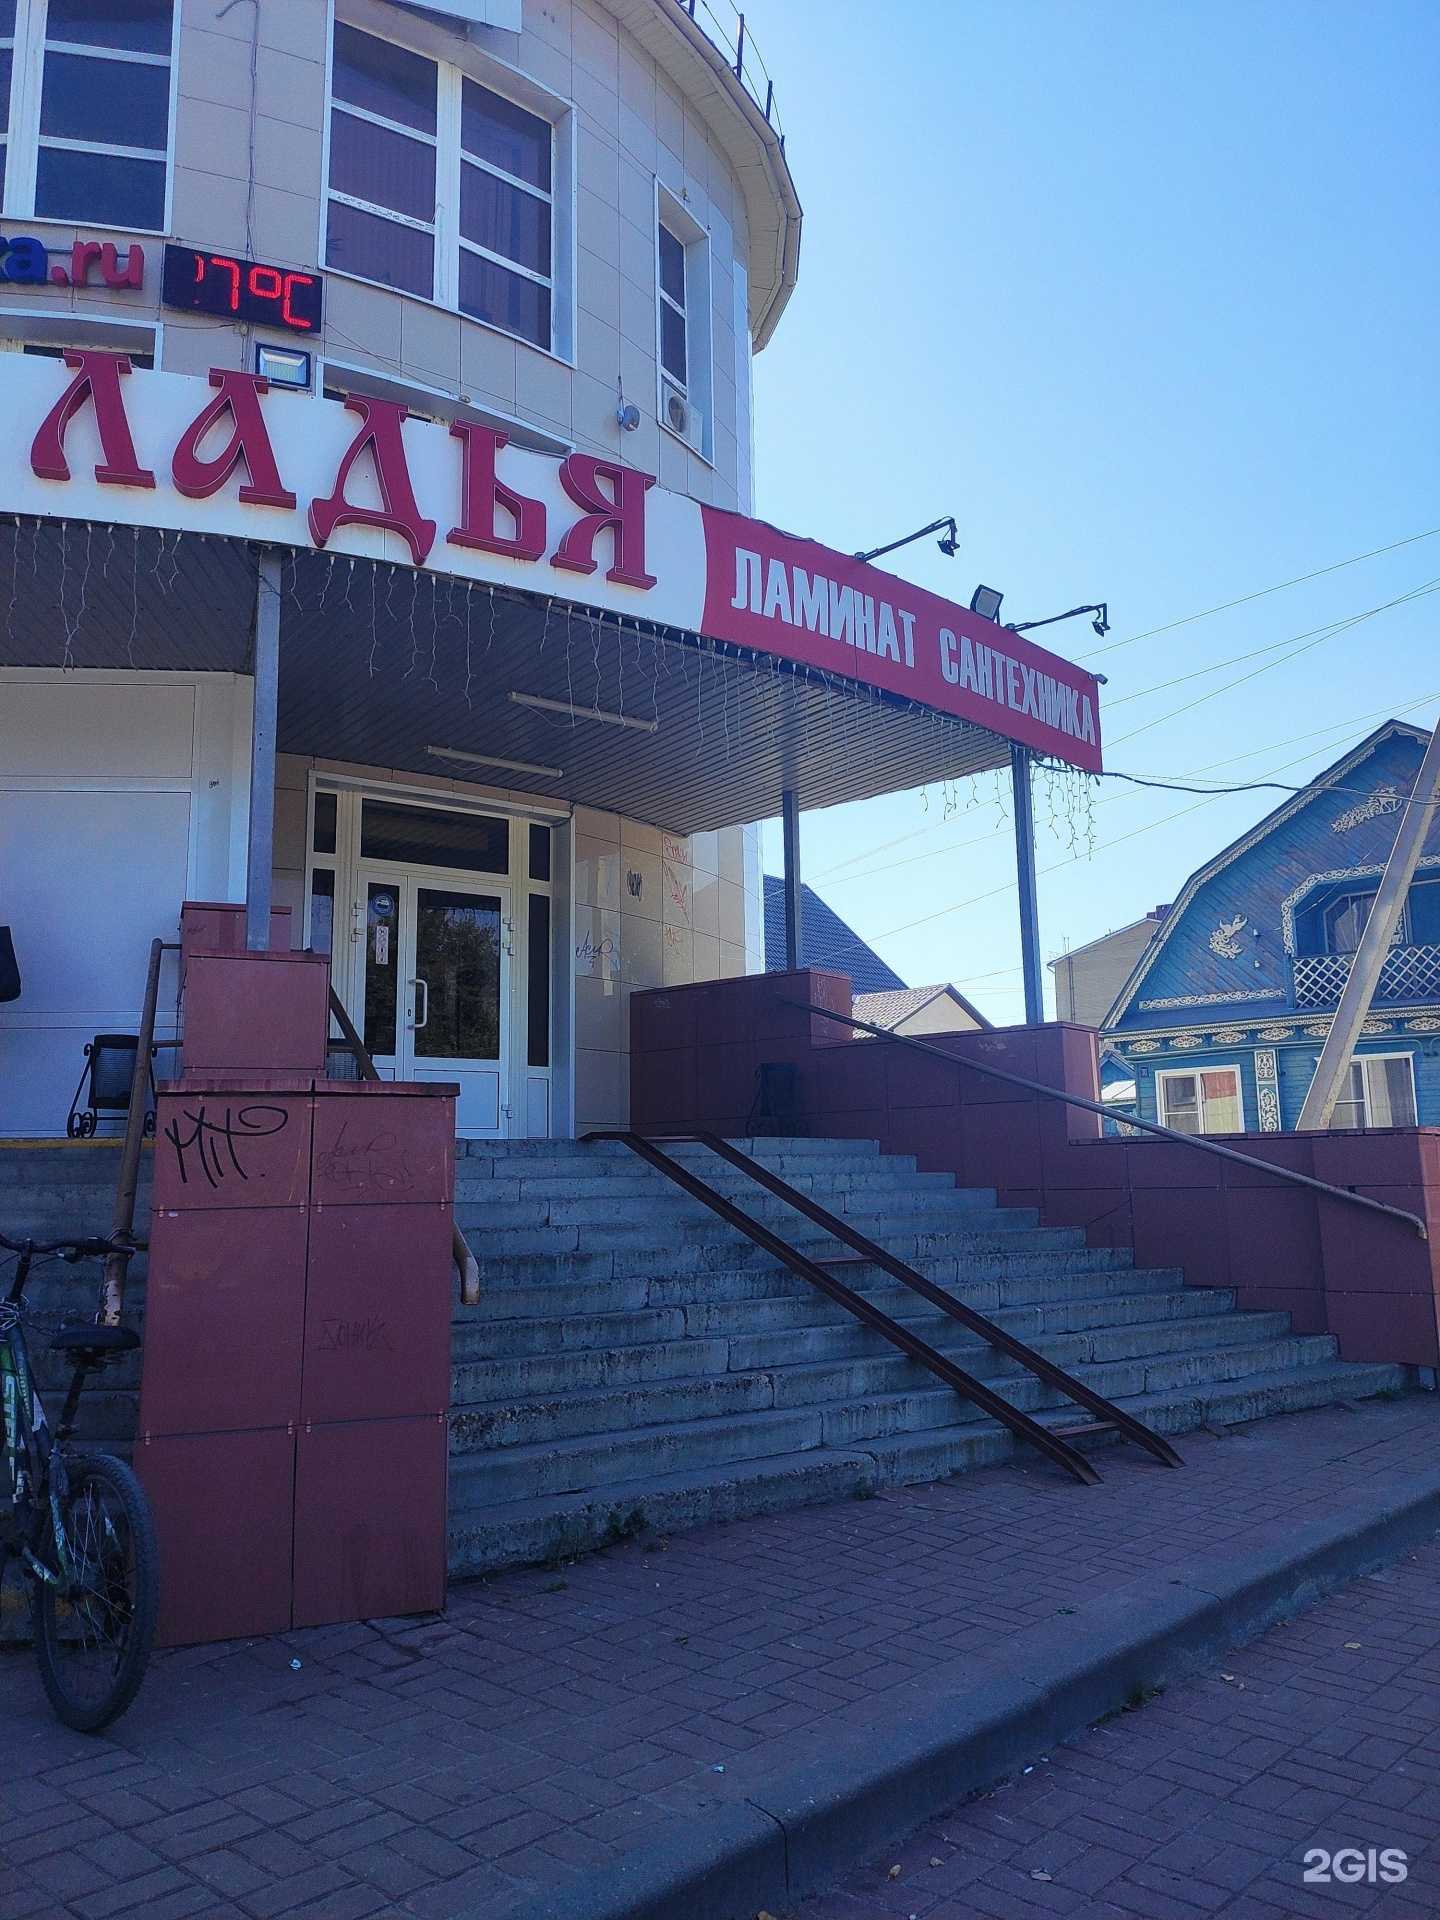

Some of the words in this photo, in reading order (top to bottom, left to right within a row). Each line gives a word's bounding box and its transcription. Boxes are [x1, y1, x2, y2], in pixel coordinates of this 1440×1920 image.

[0, 236, 145, 290] a.ru
[30, 348, 658, 590] ЛАДЬЯ
[730, 547, 917, 668] ЛАМИНАТ
[939, 628, 1096, 746] САНТЕХНИКА
